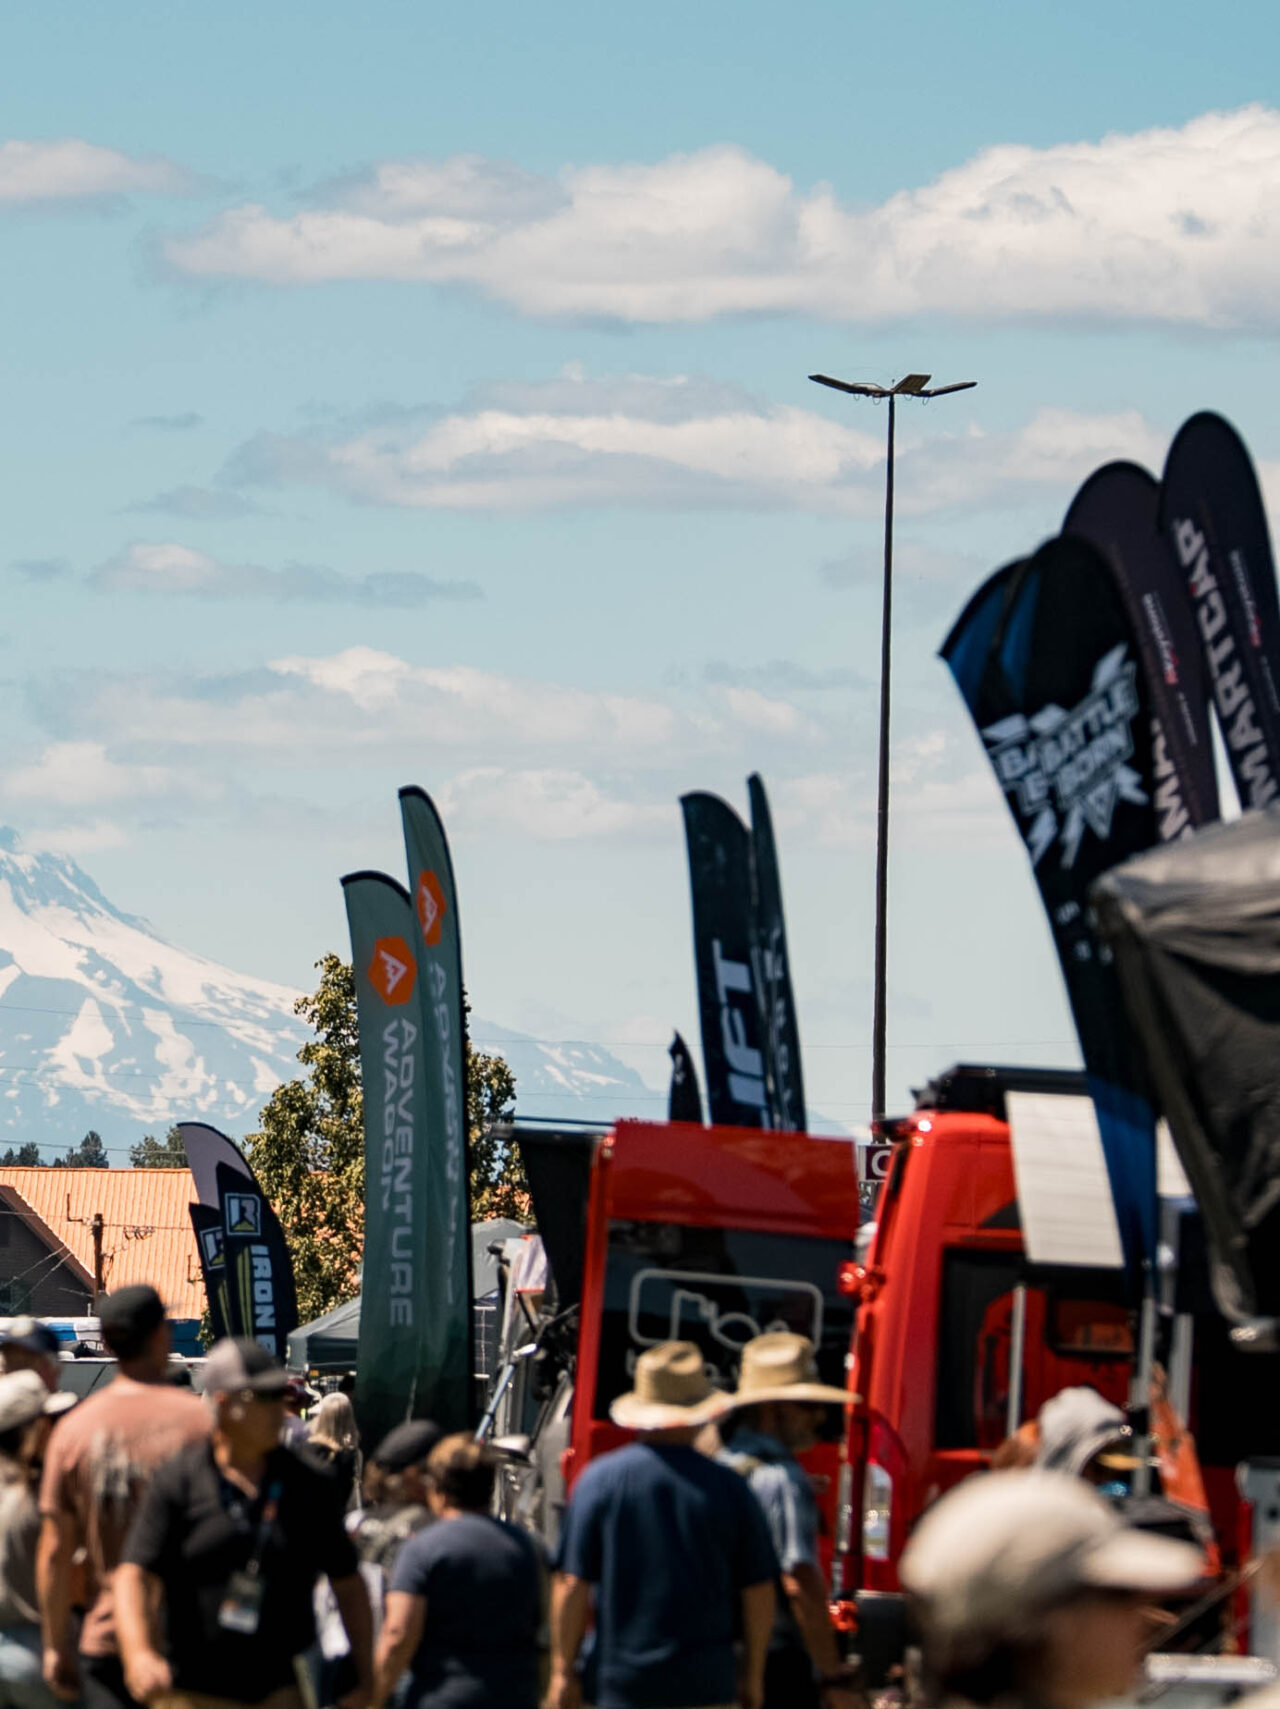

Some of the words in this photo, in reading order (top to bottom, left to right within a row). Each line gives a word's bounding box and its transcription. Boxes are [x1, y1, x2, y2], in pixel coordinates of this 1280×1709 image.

[712, 938, 771, 1129] IFT
[390, 1017, 418, 1327] ADVENTURE
[250, 1244, 277, 1329] IRON
